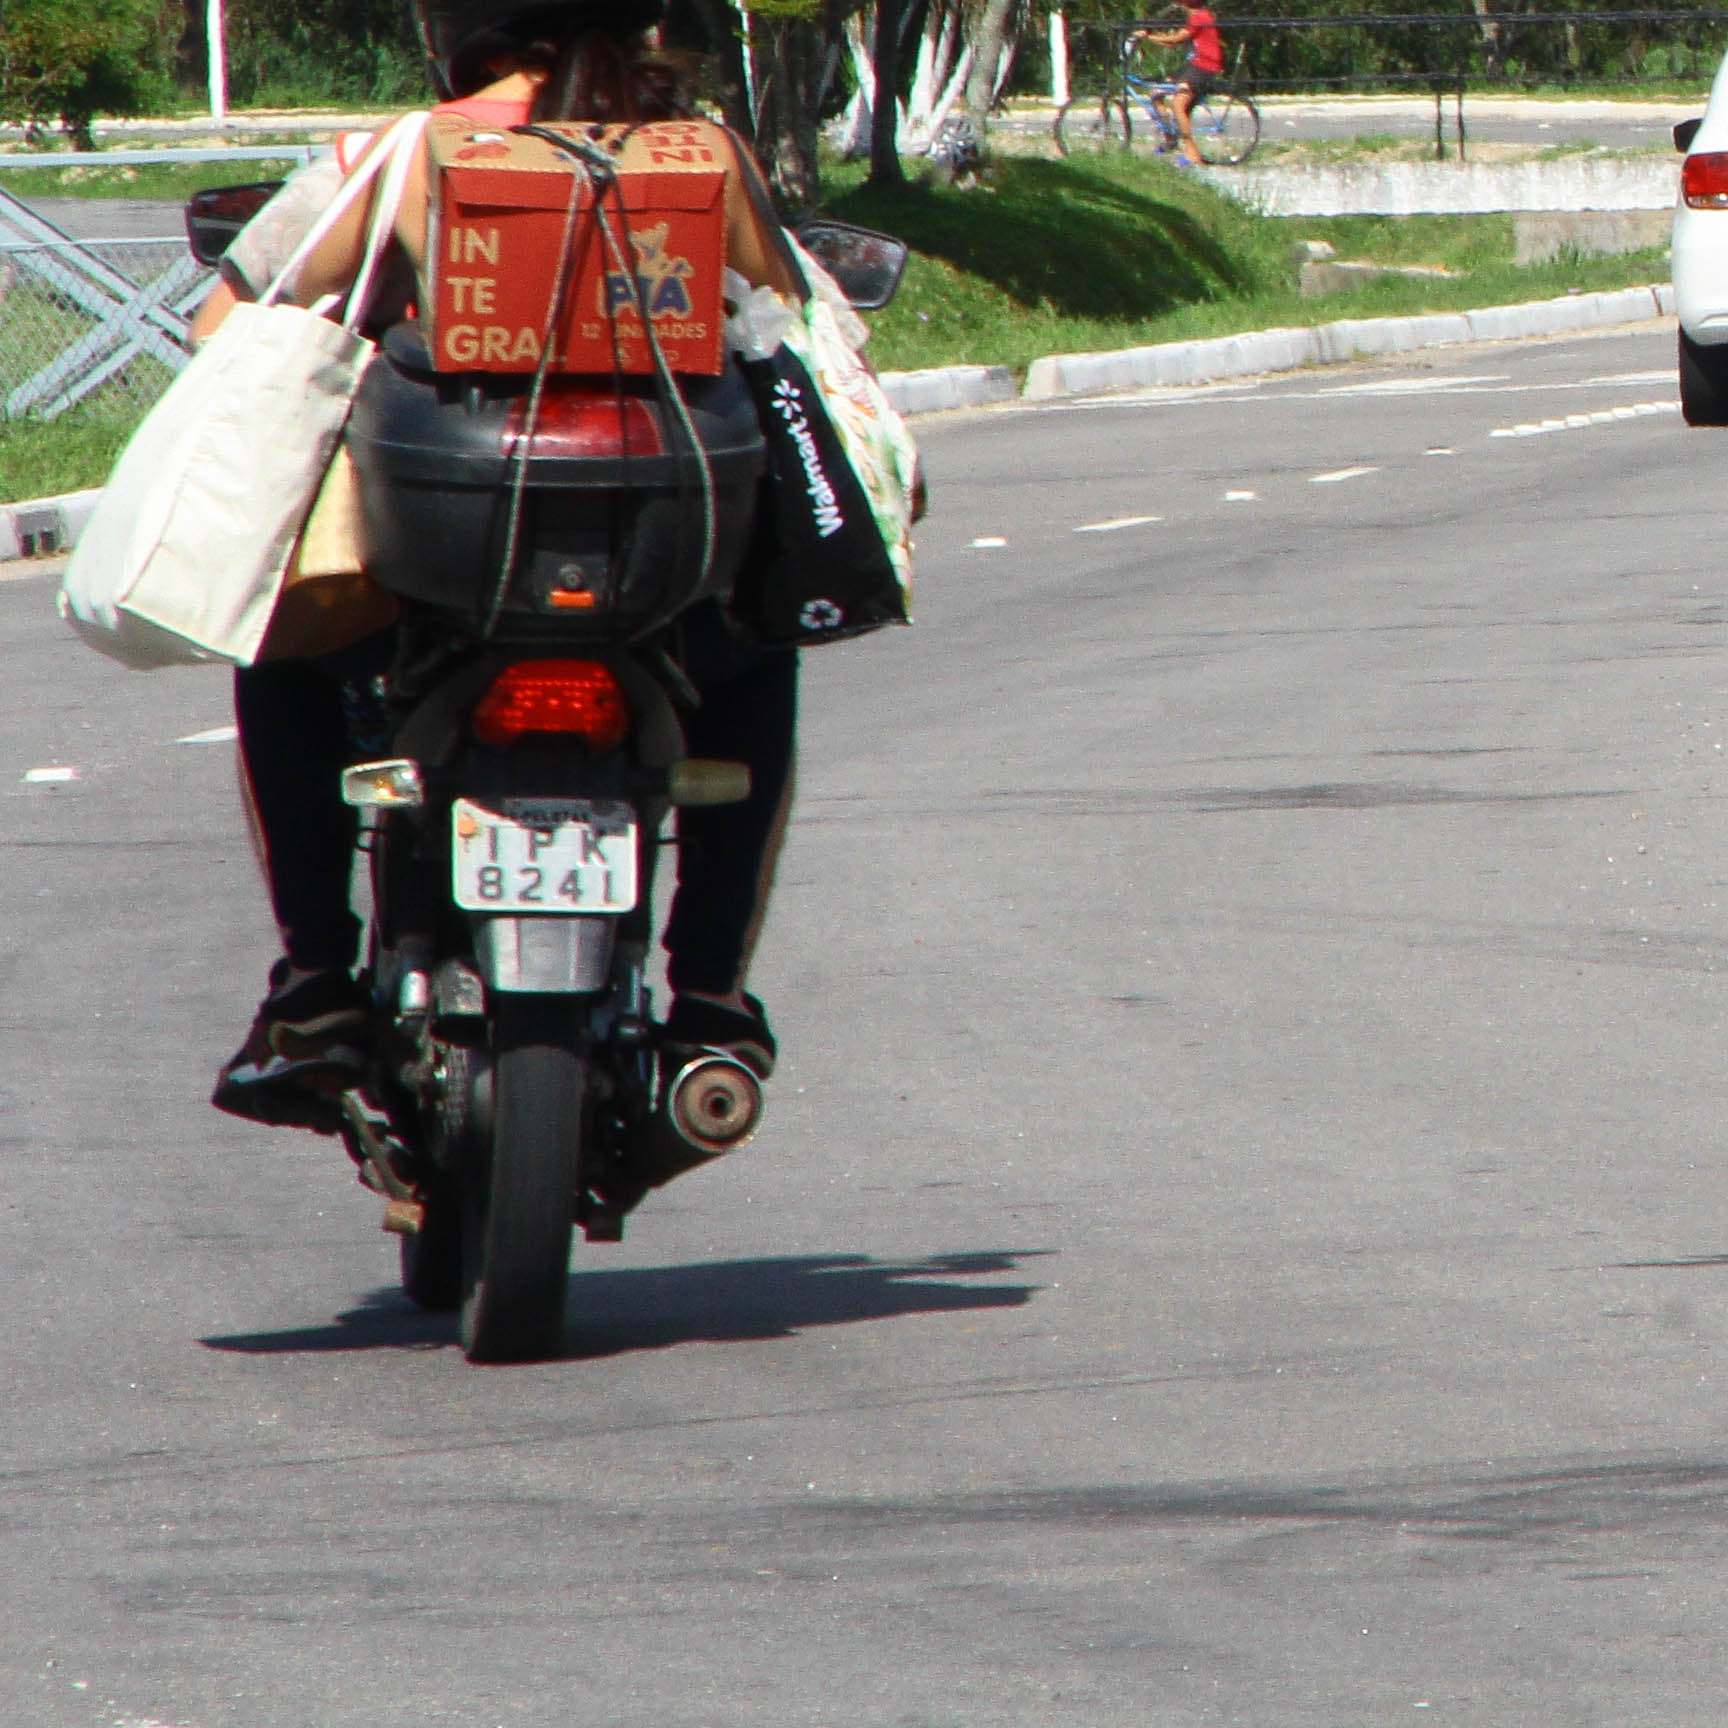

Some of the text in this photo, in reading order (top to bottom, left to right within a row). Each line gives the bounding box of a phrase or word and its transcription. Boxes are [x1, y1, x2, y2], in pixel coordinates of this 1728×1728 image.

[449, 227, 500, 264] IN
[446, 276, 497, 315] TE
[786, 415, 845, 539] Walmart
[478, 865, 612, 905] 8241
